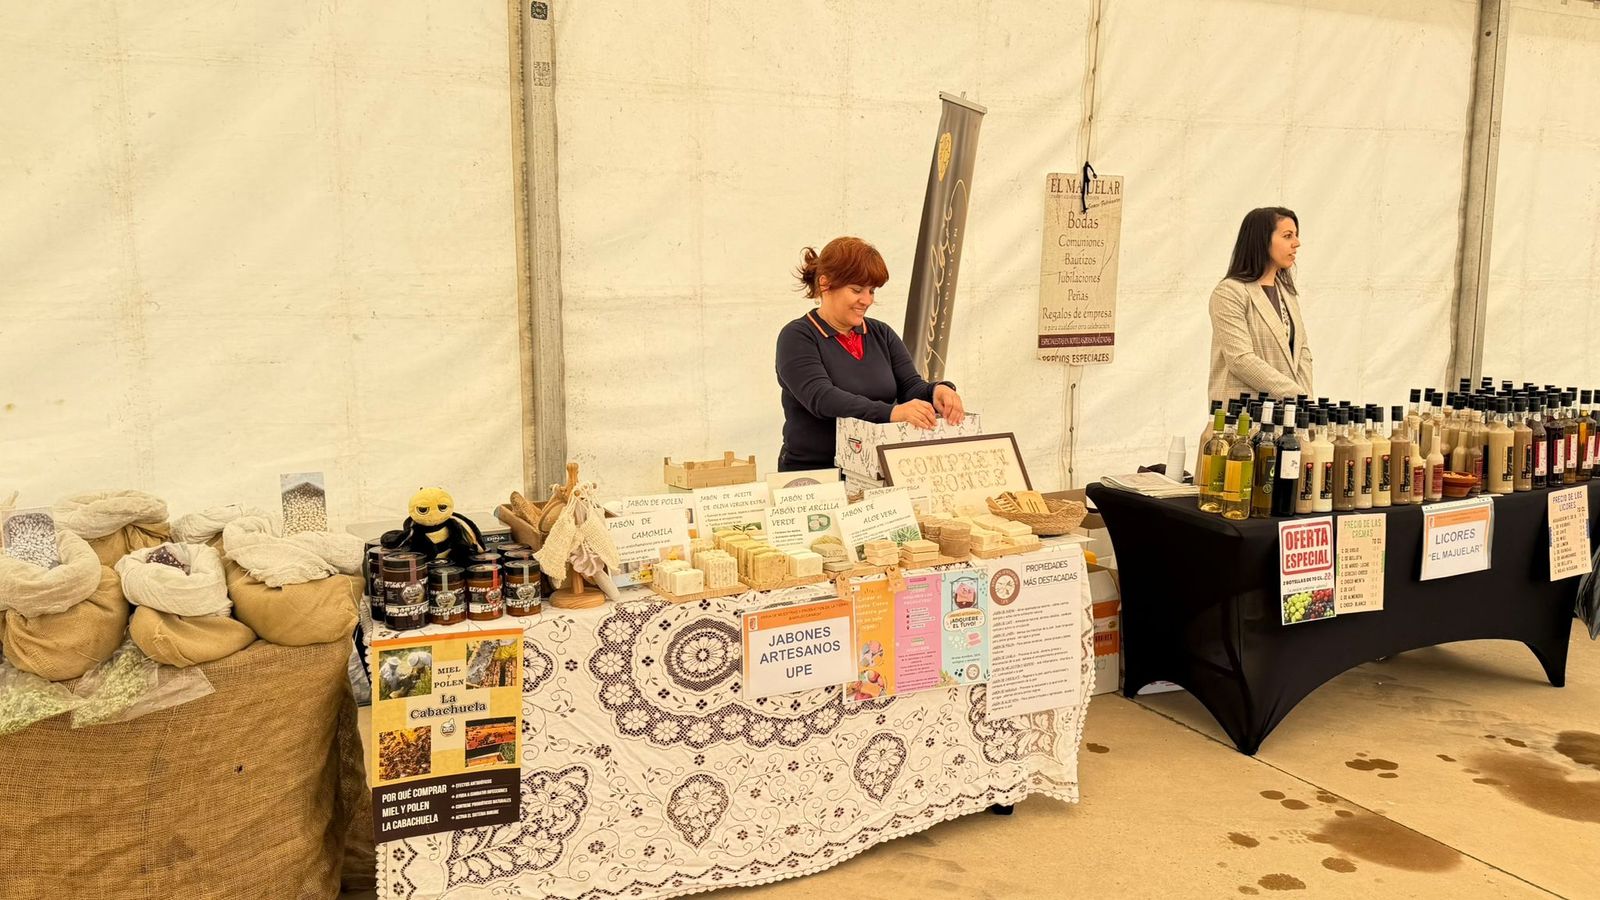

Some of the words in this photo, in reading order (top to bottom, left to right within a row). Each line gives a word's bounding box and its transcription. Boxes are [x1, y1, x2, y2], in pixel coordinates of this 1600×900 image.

[1050, 178, 1063, 193] EL
[1066, 179, 1120, 194] MAUELAR
[1068, 210, 1099, 229] Bodas
[1058, 234, 1104, 247] Comuniones
[1064, 252, 1096, 265] Bautizos
[1058, 271, 1100, 285] Jubilaciones
[1068, 288, 1088, 301] Peñas
[1042, 307, 1071, 322] Regalos
[1073, 307, 1081, 318] de
[1084, 310, 1112, 320] empresa
[1072, 353, 1110, 362] ESPECIALES
[1574, 491, 1582, 499] LOS
[809, 502, 839, 511] ARCILLA
[1559, 501, 1576, 511] LICORES
[772, 518, 796, 526] VERDE
[864, 513, 879, 524] ALOE
[880, 509, 897, 518] VERA
[1344, 520, 1362, 529] PRECIO
[1371, 518, 1381, 527] LAS
[632, 528, 672, 539] CAMOMILA
[1286, 528, 1328, 550] OFERTA
[1352, 529, 1373, 538] CREMAS
[1436, 528, 1475, 544] LICORES
[1286, 549, 1329, 569] ESPECIAL
[1026, 560, 1068, 573] PROPIEDADES
[1023, 576, 1037, 586] MÁS
[1038, 572, 1078, 584] DESTACADAS
[768, 626, 831, 647] JABONES
[760, 640, 841, 664] ARTESANOS
[786, 664, 812, 678] UPE
[434, 679, 464, 688] POLEN
[441, 695, 456, 704] La
[410, 702, 487, 719] Cabachuela
[382, 792, 396, 803] POR
[398, 788, 412, 800] QUÉ
[413, 784, 447, 797] COMPRAR
[382, 806, 400, 818] MIEL
[400, 805, 406, 814] Y
[407, 801, 430, 813] POLEN
[382, 822, 391, 832] LA
[392, 814, 438, 829] CABACHUELA
